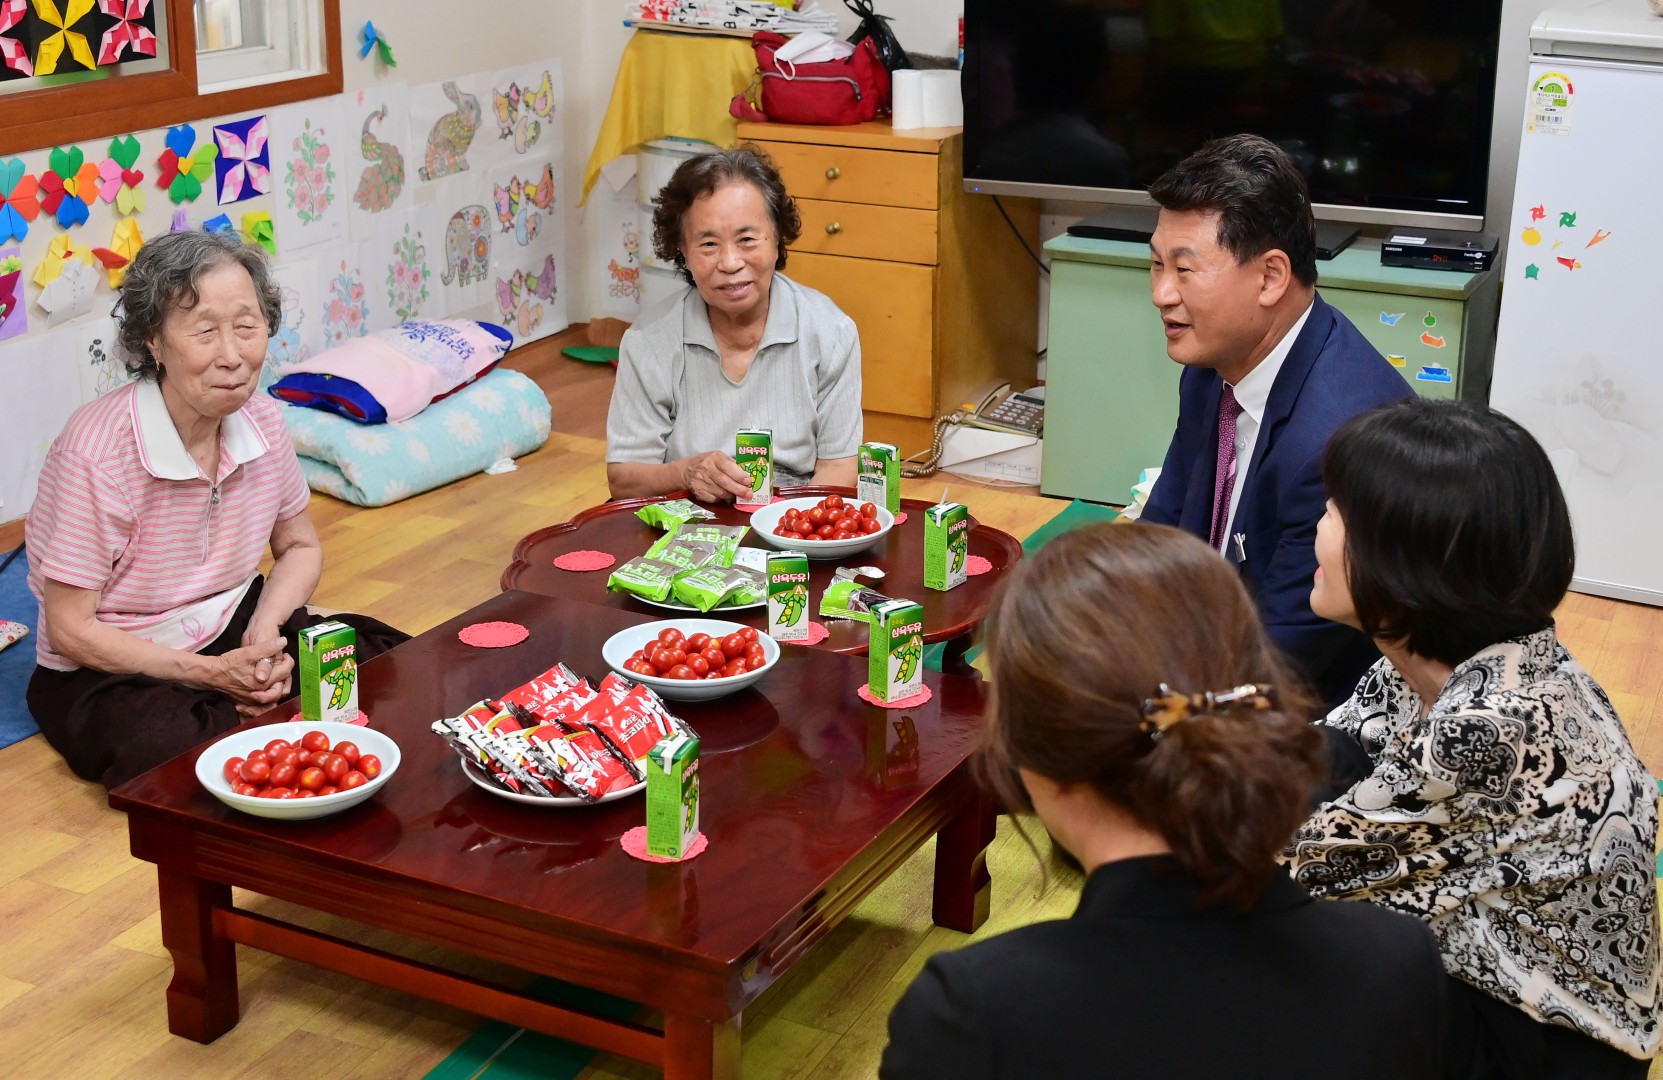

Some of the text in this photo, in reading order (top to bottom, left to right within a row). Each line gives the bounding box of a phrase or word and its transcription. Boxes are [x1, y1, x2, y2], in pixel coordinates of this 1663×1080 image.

[738, 446, 768, 456] 삼육두유
[758, 457, 765, 466] A
[771, 573, 807, 584] 삼육두유
[795, 586, 803, 595] A
[892, 622, 922, 638] 삼육두유
[911, 636, 920, 647] A
[322, 644, 355, 663] 삼육두유
[344, 659, 353, 671] A
[620, 714, 638, 730] 리온
[619, 714, 652, 744] 초코파이
